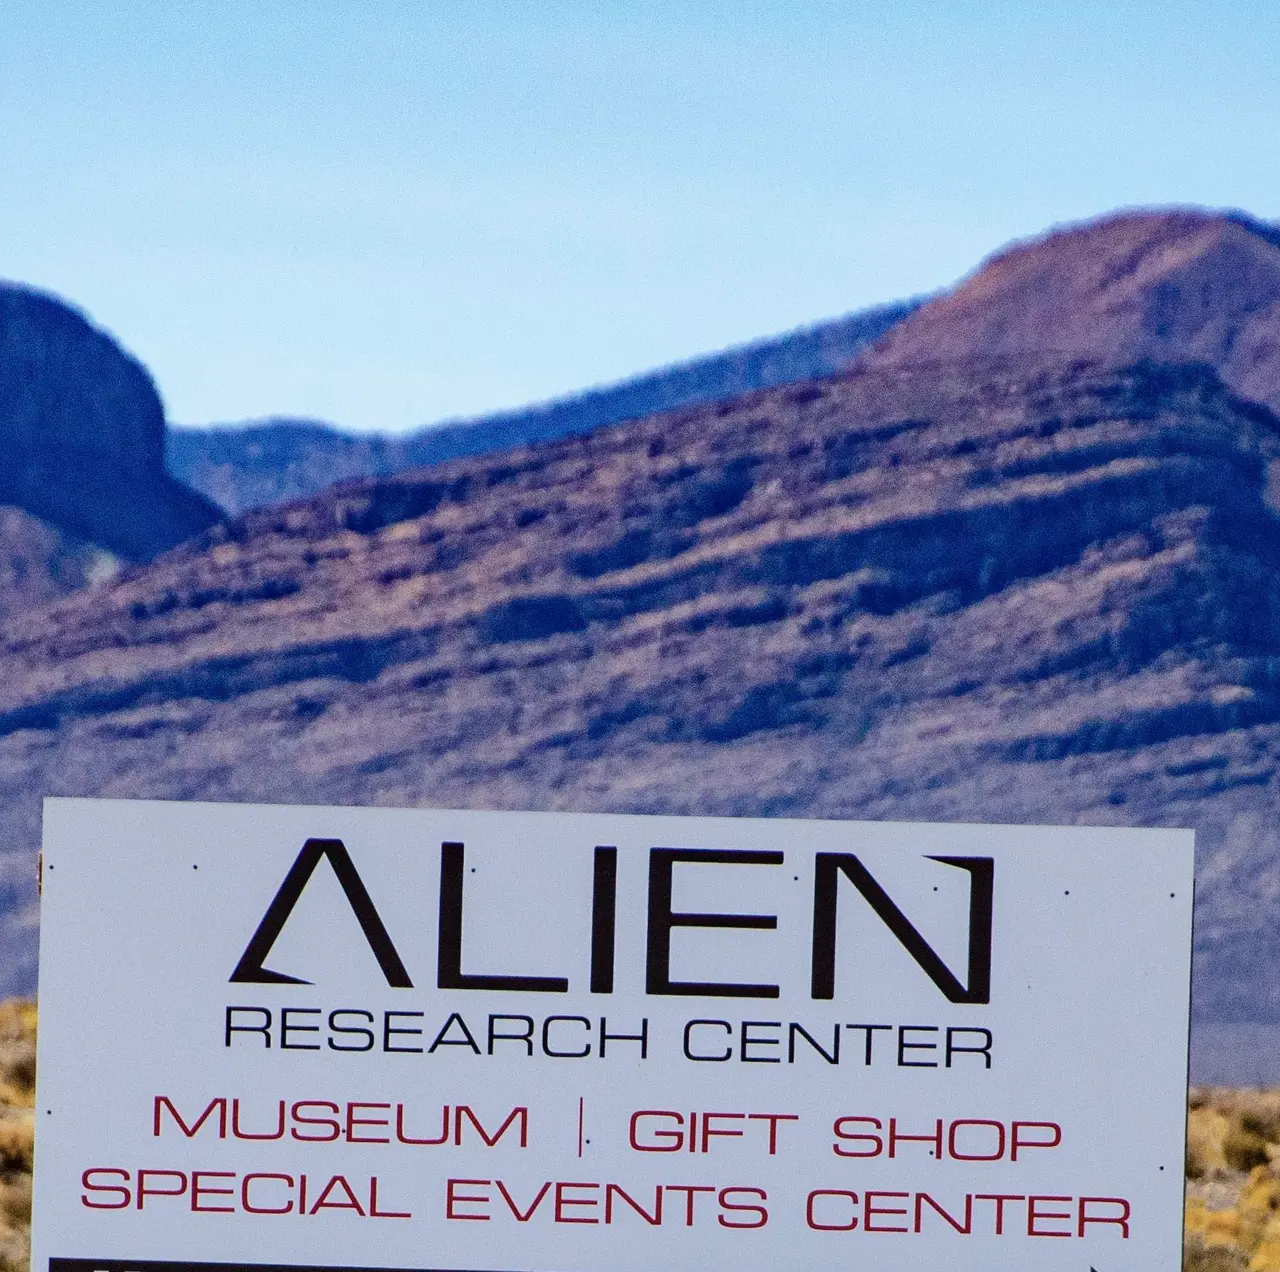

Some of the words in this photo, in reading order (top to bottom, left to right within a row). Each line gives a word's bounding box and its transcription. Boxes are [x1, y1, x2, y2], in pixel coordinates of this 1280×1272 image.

[229, 839, 994, 1004] ALIEN
[225, 1007, 648, 1059] RESEARCH
[684, 1020, 992, 1069] CENTER
[154, 1096, 527, 1147] MUSEUM
[630, 1111, 798, 1154] GIFT
[833, 1117, 1061, 1161] SHOP
[82, 1168, 411, 1218] SPECIAL
[447, 1179, 768, 1228] EVENTS
[807, 1190, 1130, 1238] CENTER
